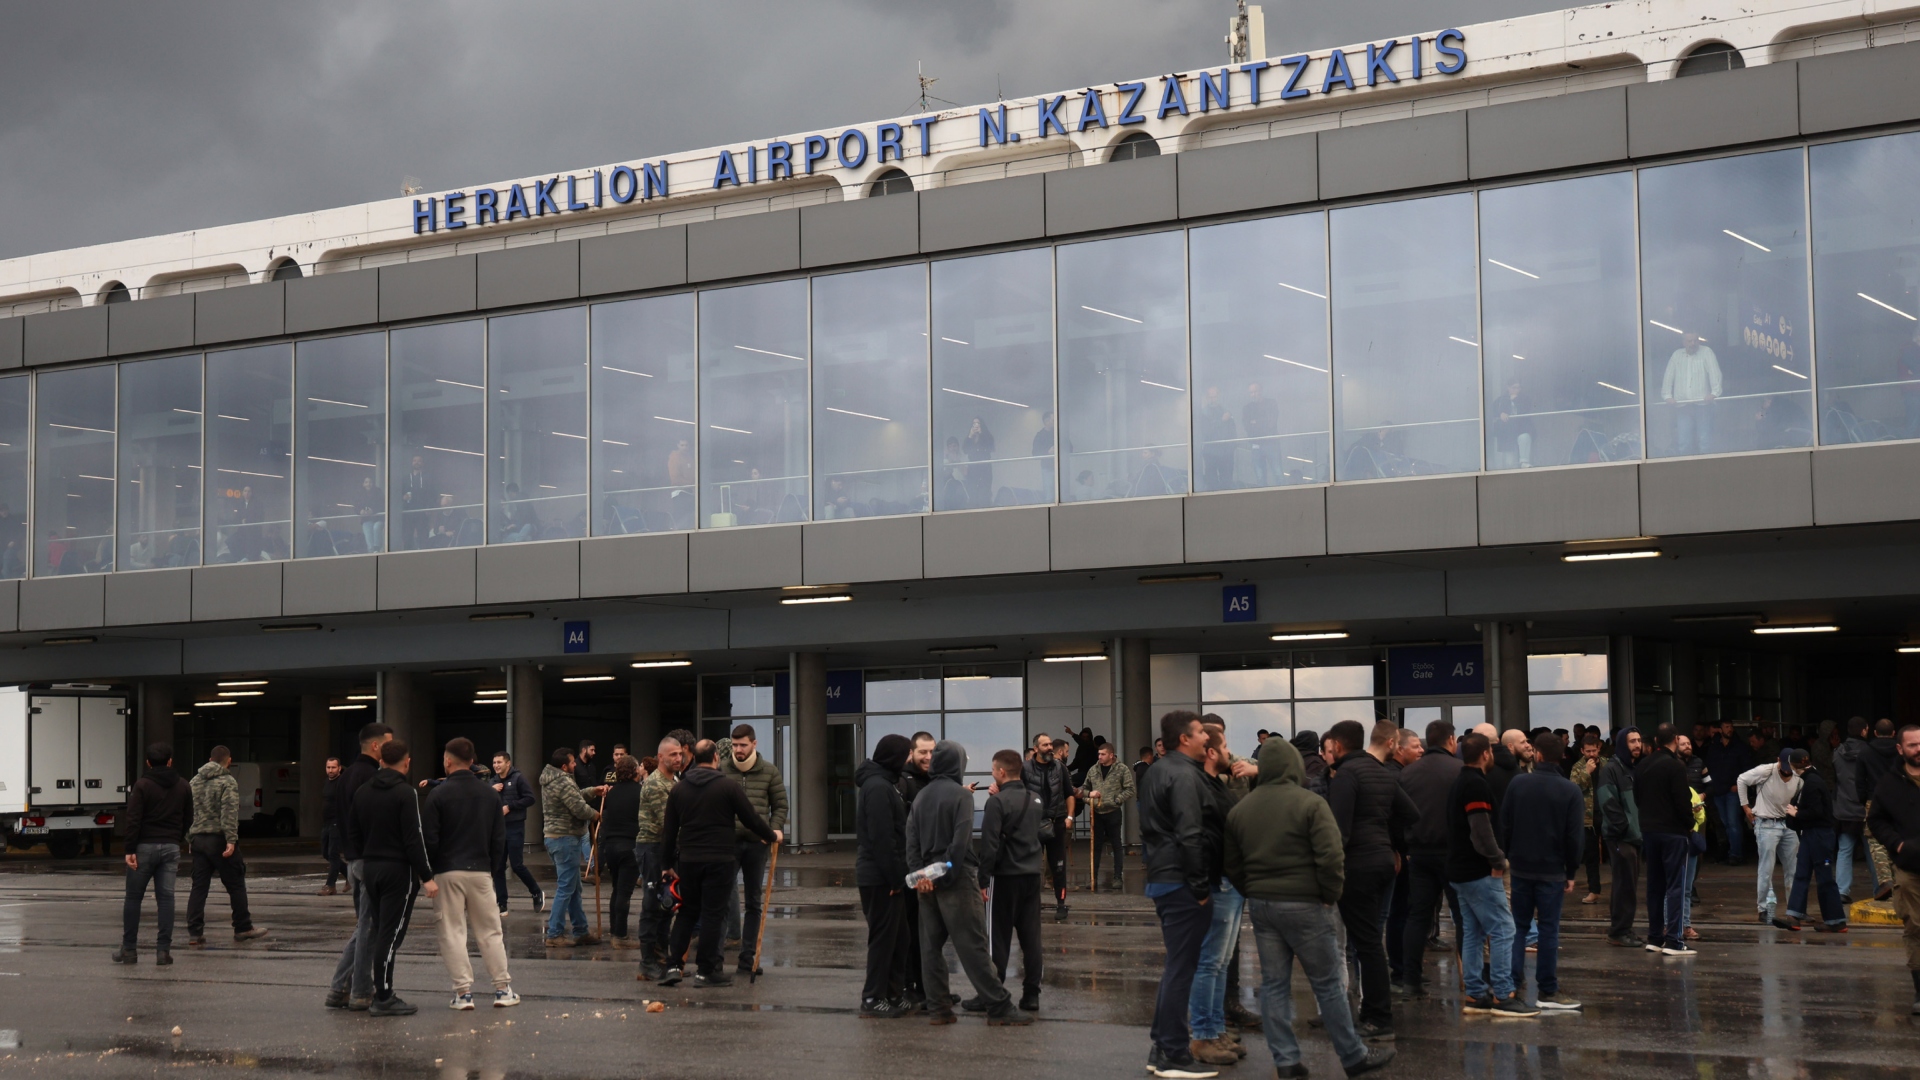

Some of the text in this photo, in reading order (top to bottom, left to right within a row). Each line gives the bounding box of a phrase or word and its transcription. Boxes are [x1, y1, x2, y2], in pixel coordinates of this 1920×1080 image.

[412, 158, 669, 235] HERAKLION
[712, 115, 938, 190] AIRPORT
[1229, 595, 1250, 612] A5
[568, 630, 585, 644] A4
[1412, 670, 1434, 679] Gate
[1451, 661, 1475, 677] A5
[826, 685, 841, 699] A4
